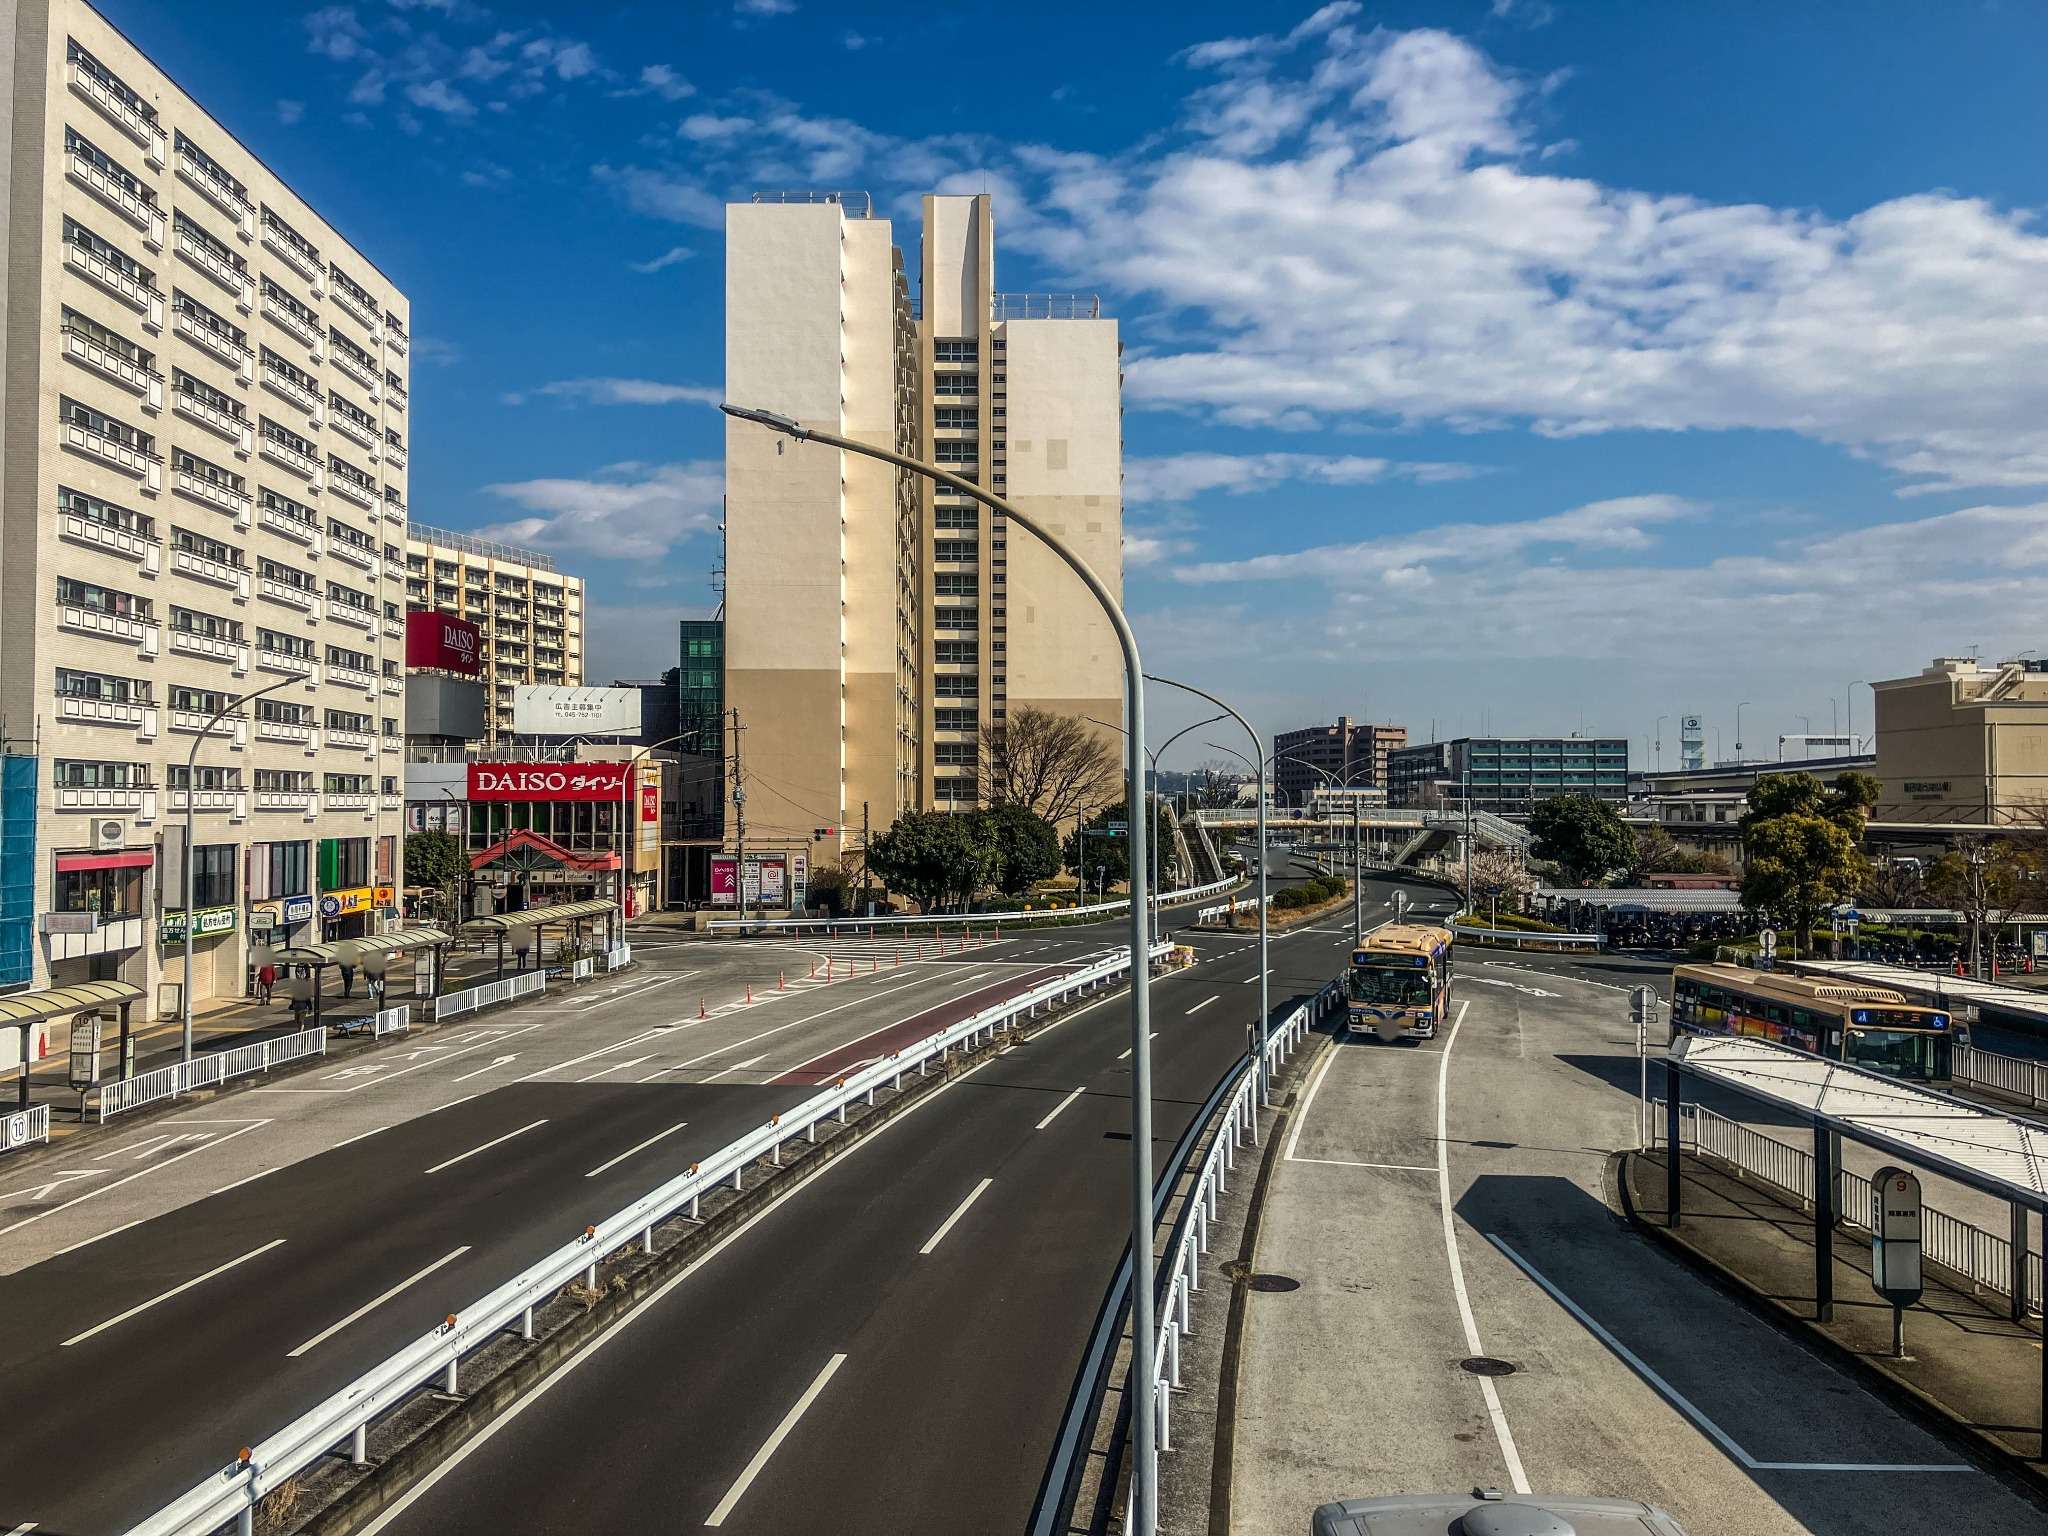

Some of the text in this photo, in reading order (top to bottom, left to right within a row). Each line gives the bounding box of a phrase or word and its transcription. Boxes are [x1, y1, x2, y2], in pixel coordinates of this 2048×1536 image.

[444, 625, 474, 650] DAISO
[555, 703, 602, 711] 広告主募集中
[477, 772, 623, 791] DAISO ダイソー
[78, 1017, 89, 1025] 10
[14, 1121, 25, 1138] 10
[1896, 1180, 1906, 1192] 9
